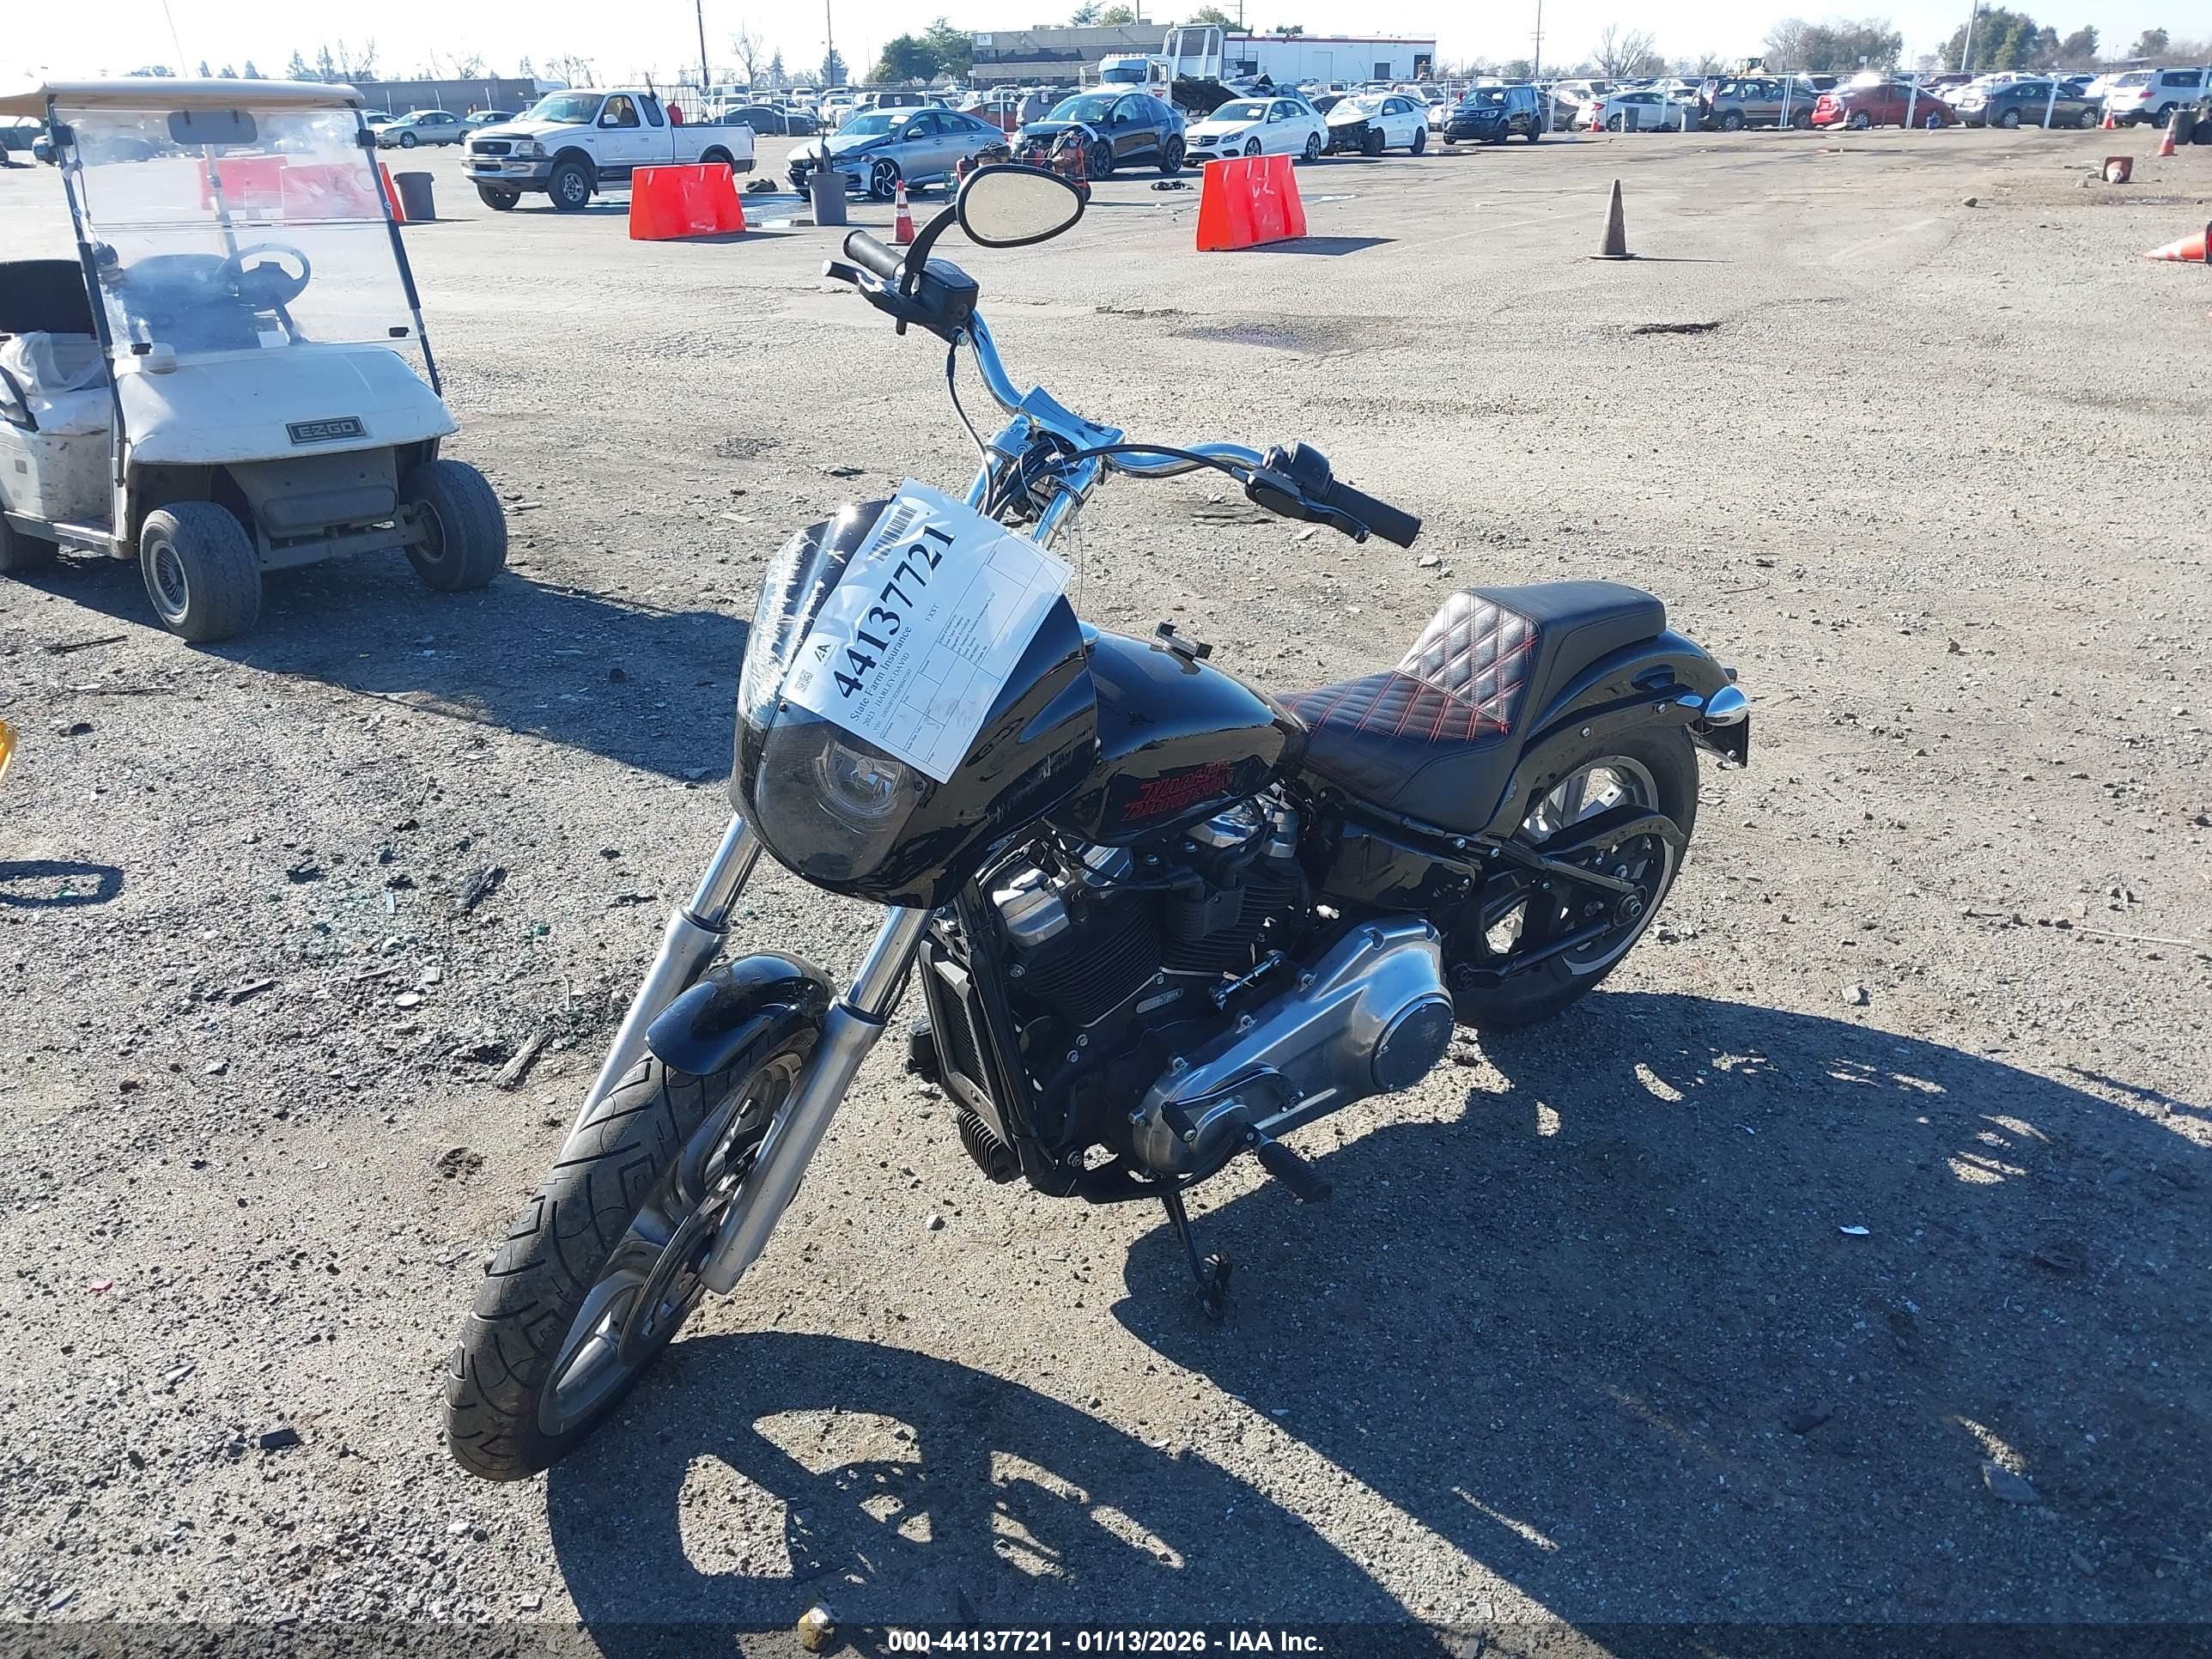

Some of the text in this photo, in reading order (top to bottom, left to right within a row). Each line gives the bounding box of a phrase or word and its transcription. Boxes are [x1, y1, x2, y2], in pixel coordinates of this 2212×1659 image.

[833, 526, 957, 699] 44137721
[849, 626, 912, 722] State Farm Insurance
[862, 710, 876, 727] 2023
[874, 653, 910, 708] HARLEY-DAVID
[924, 603, 940, 623] FXST
